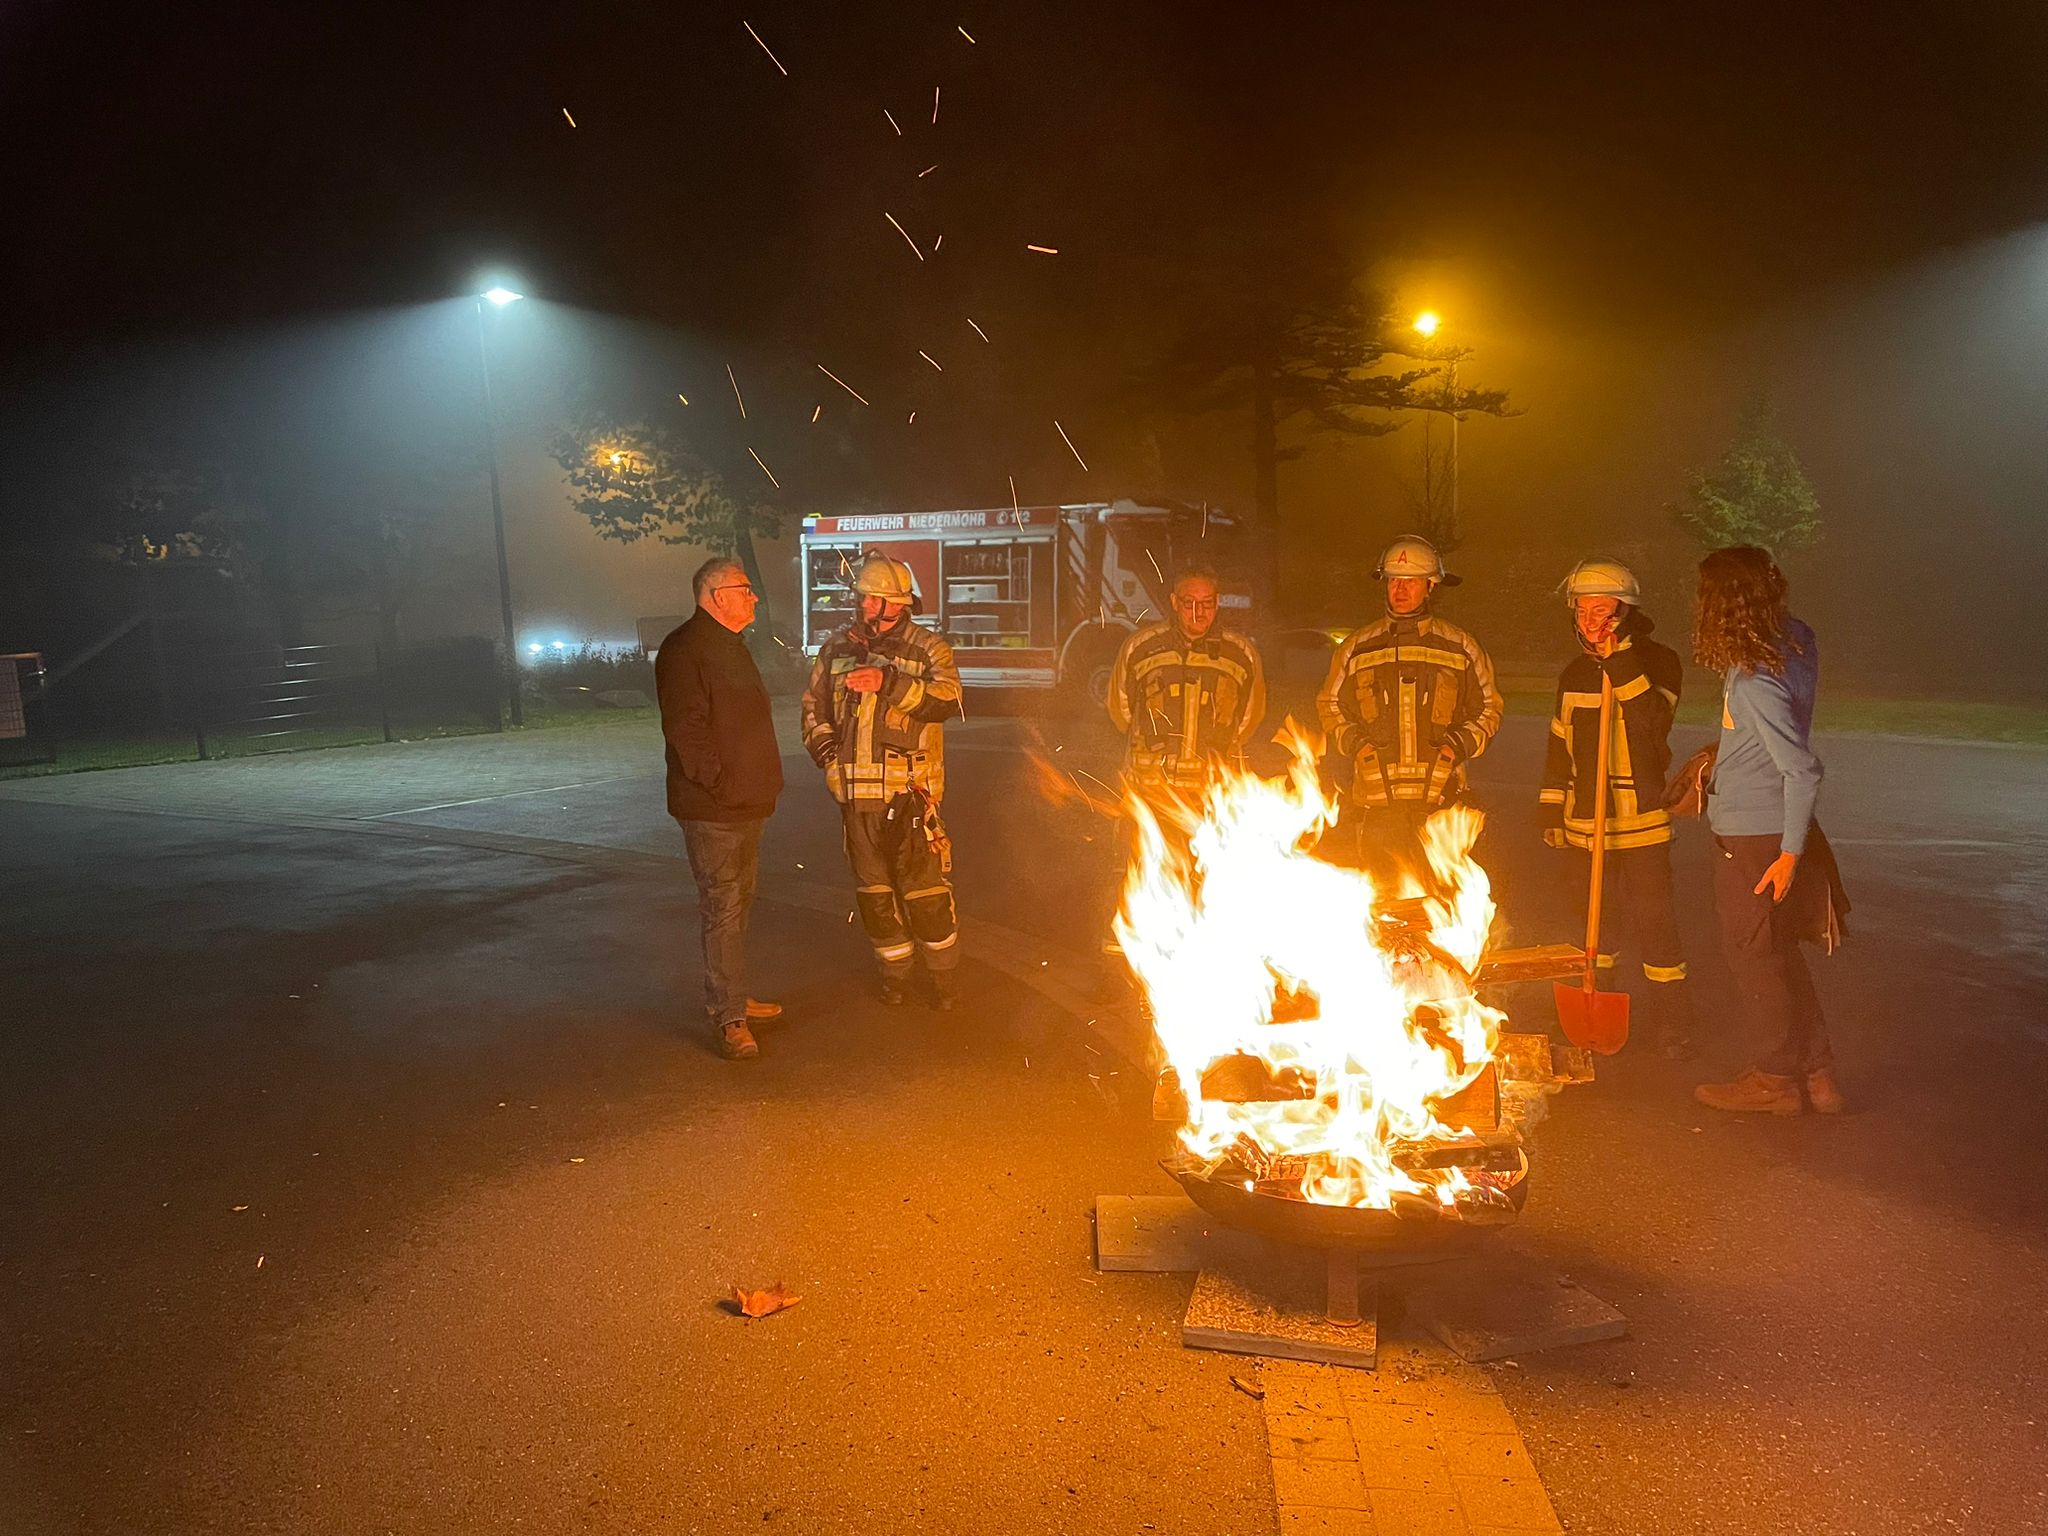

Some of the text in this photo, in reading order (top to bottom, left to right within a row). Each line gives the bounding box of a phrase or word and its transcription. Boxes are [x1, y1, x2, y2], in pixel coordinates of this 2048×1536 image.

[837, 516, 904, 532] FEUERWEHR
[909, 512, 986, 529] NIEDERMOHR
[1397, 549, 1408, 564] A
